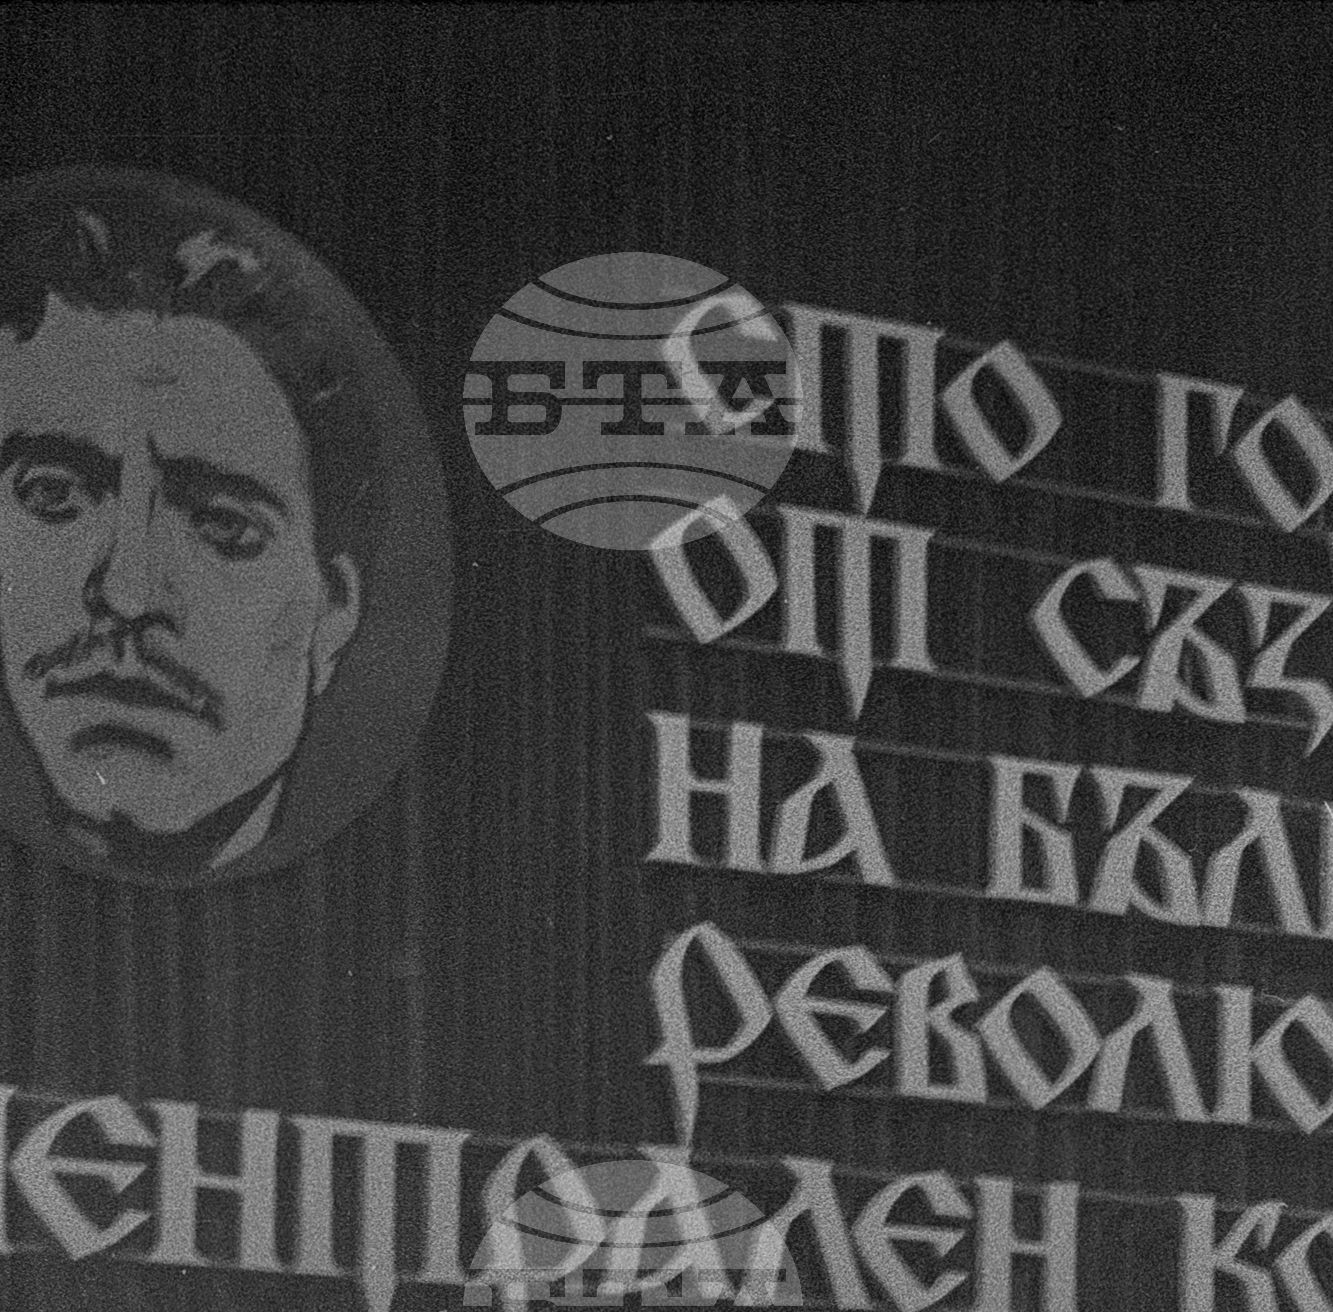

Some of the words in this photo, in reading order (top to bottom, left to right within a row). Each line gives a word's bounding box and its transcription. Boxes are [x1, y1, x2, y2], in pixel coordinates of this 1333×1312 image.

[662, 292, 1064, 517] СТО
[648, 494, 938, 720] ОТ
[645, 711, 897, 888] НА
